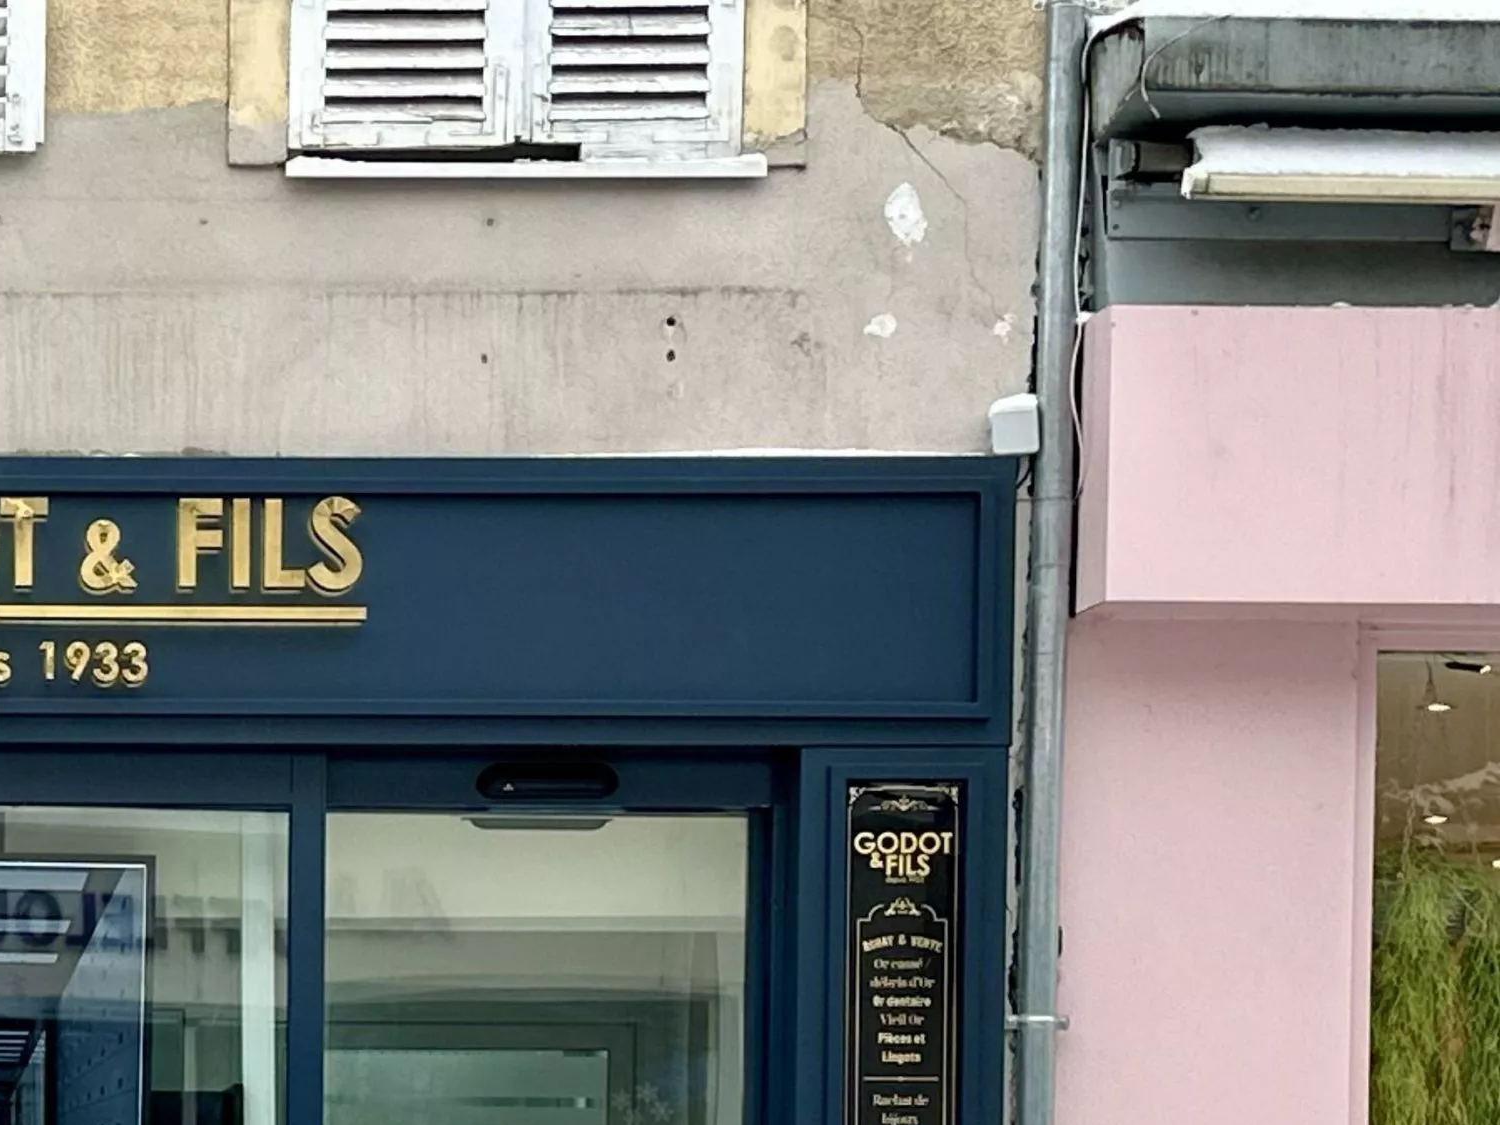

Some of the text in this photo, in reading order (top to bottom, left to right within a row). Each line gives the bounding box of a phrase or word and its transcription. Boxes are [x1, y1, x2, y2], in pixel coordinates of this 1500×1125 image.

[79, 519, 138, 594] &
[175, 496, 365, 595] FILS
[37, 641, 150, 687] 1933
[854, 832, 953, 855] GODOT
[869, 852, 931, 877] & FILS
